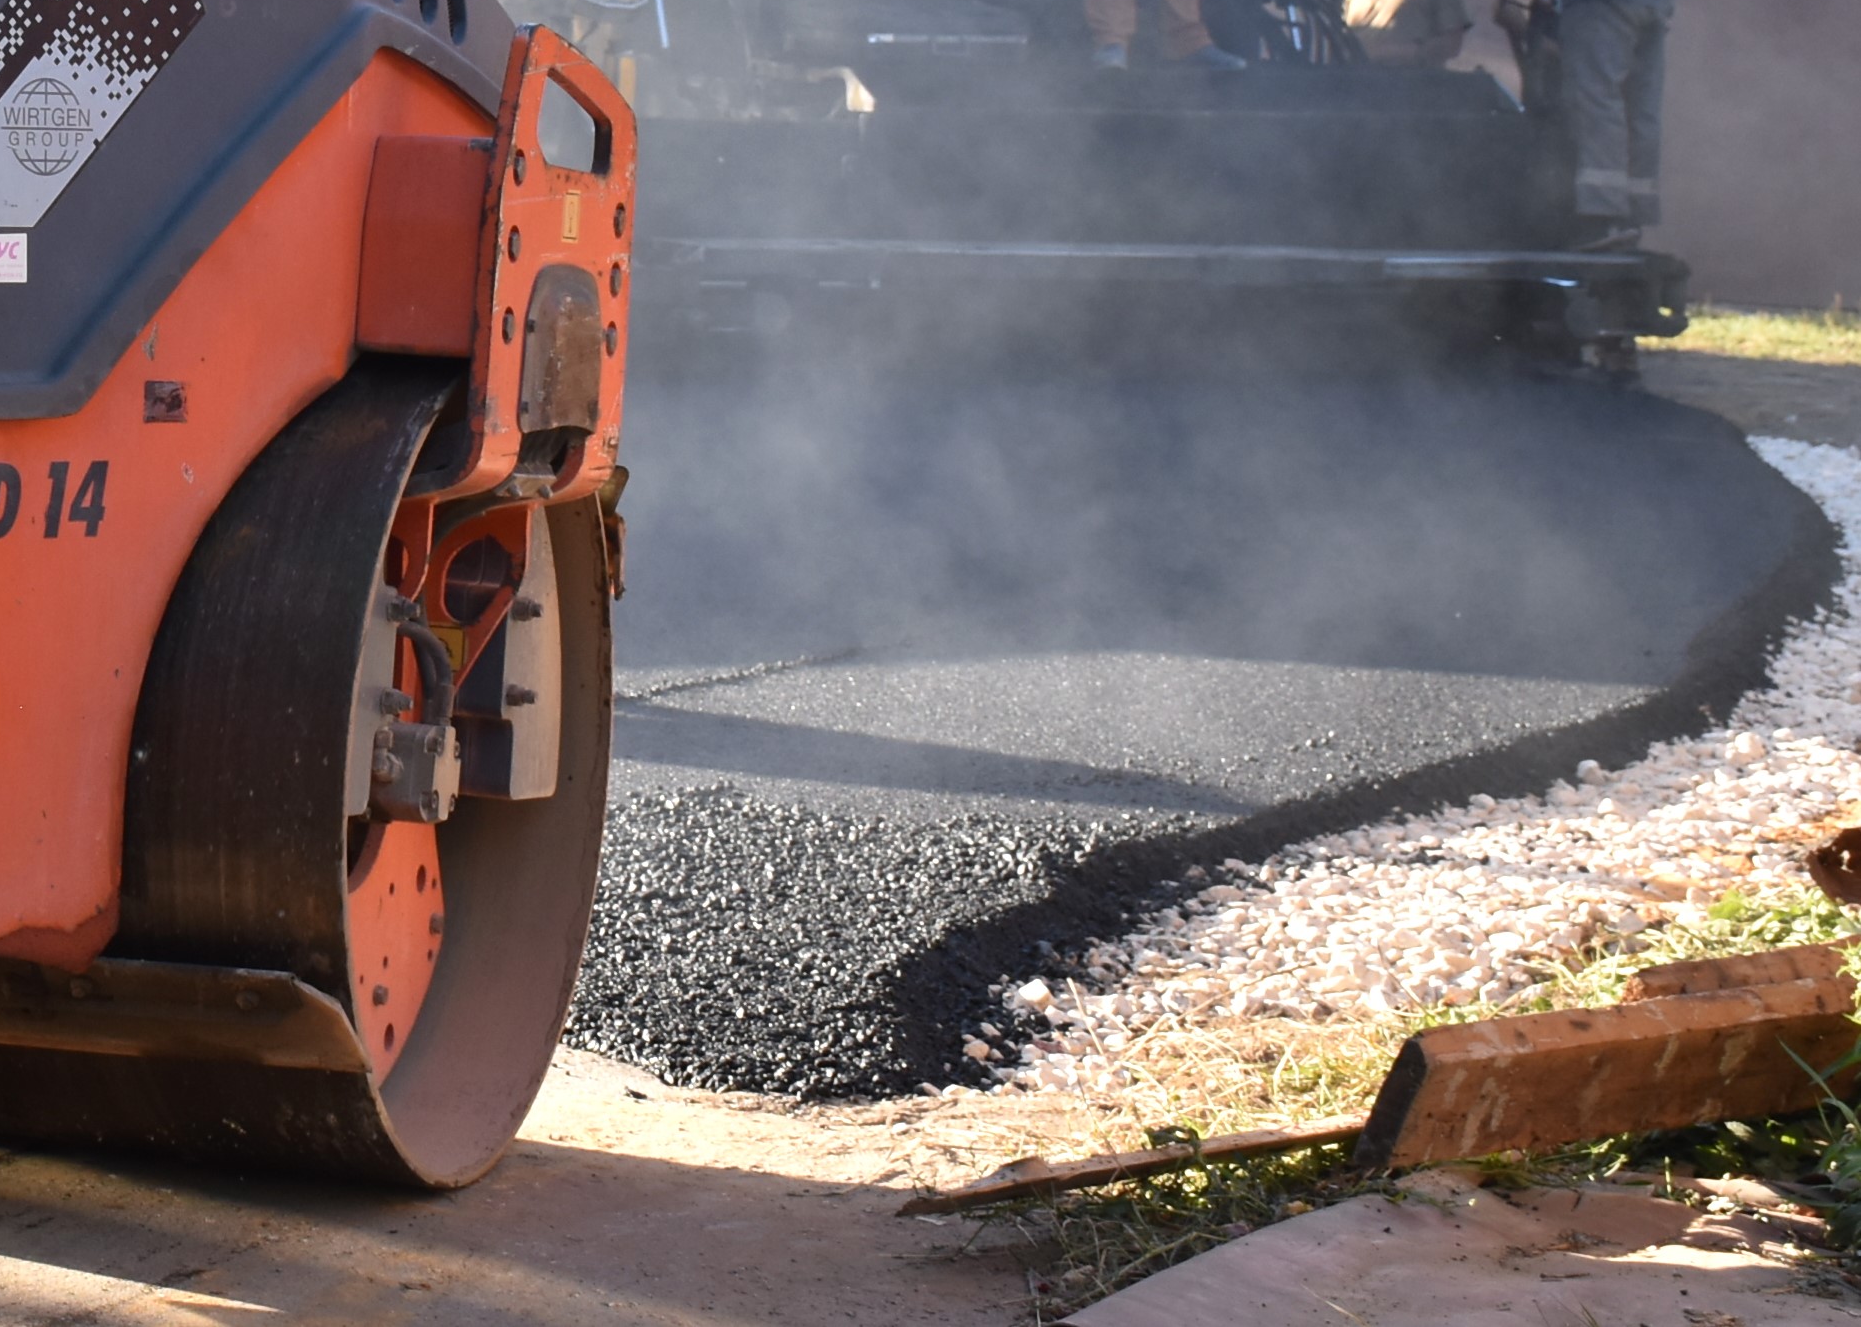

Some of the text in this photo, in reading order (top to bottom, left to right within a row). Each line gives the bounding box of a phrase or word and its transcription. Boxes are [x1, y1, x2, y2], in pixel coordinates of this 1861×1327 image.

[3, 106, 91, 127] WIRTGEN
[8, 130, 85, 148] GROUP
[43, 460, 109, 539] 14
